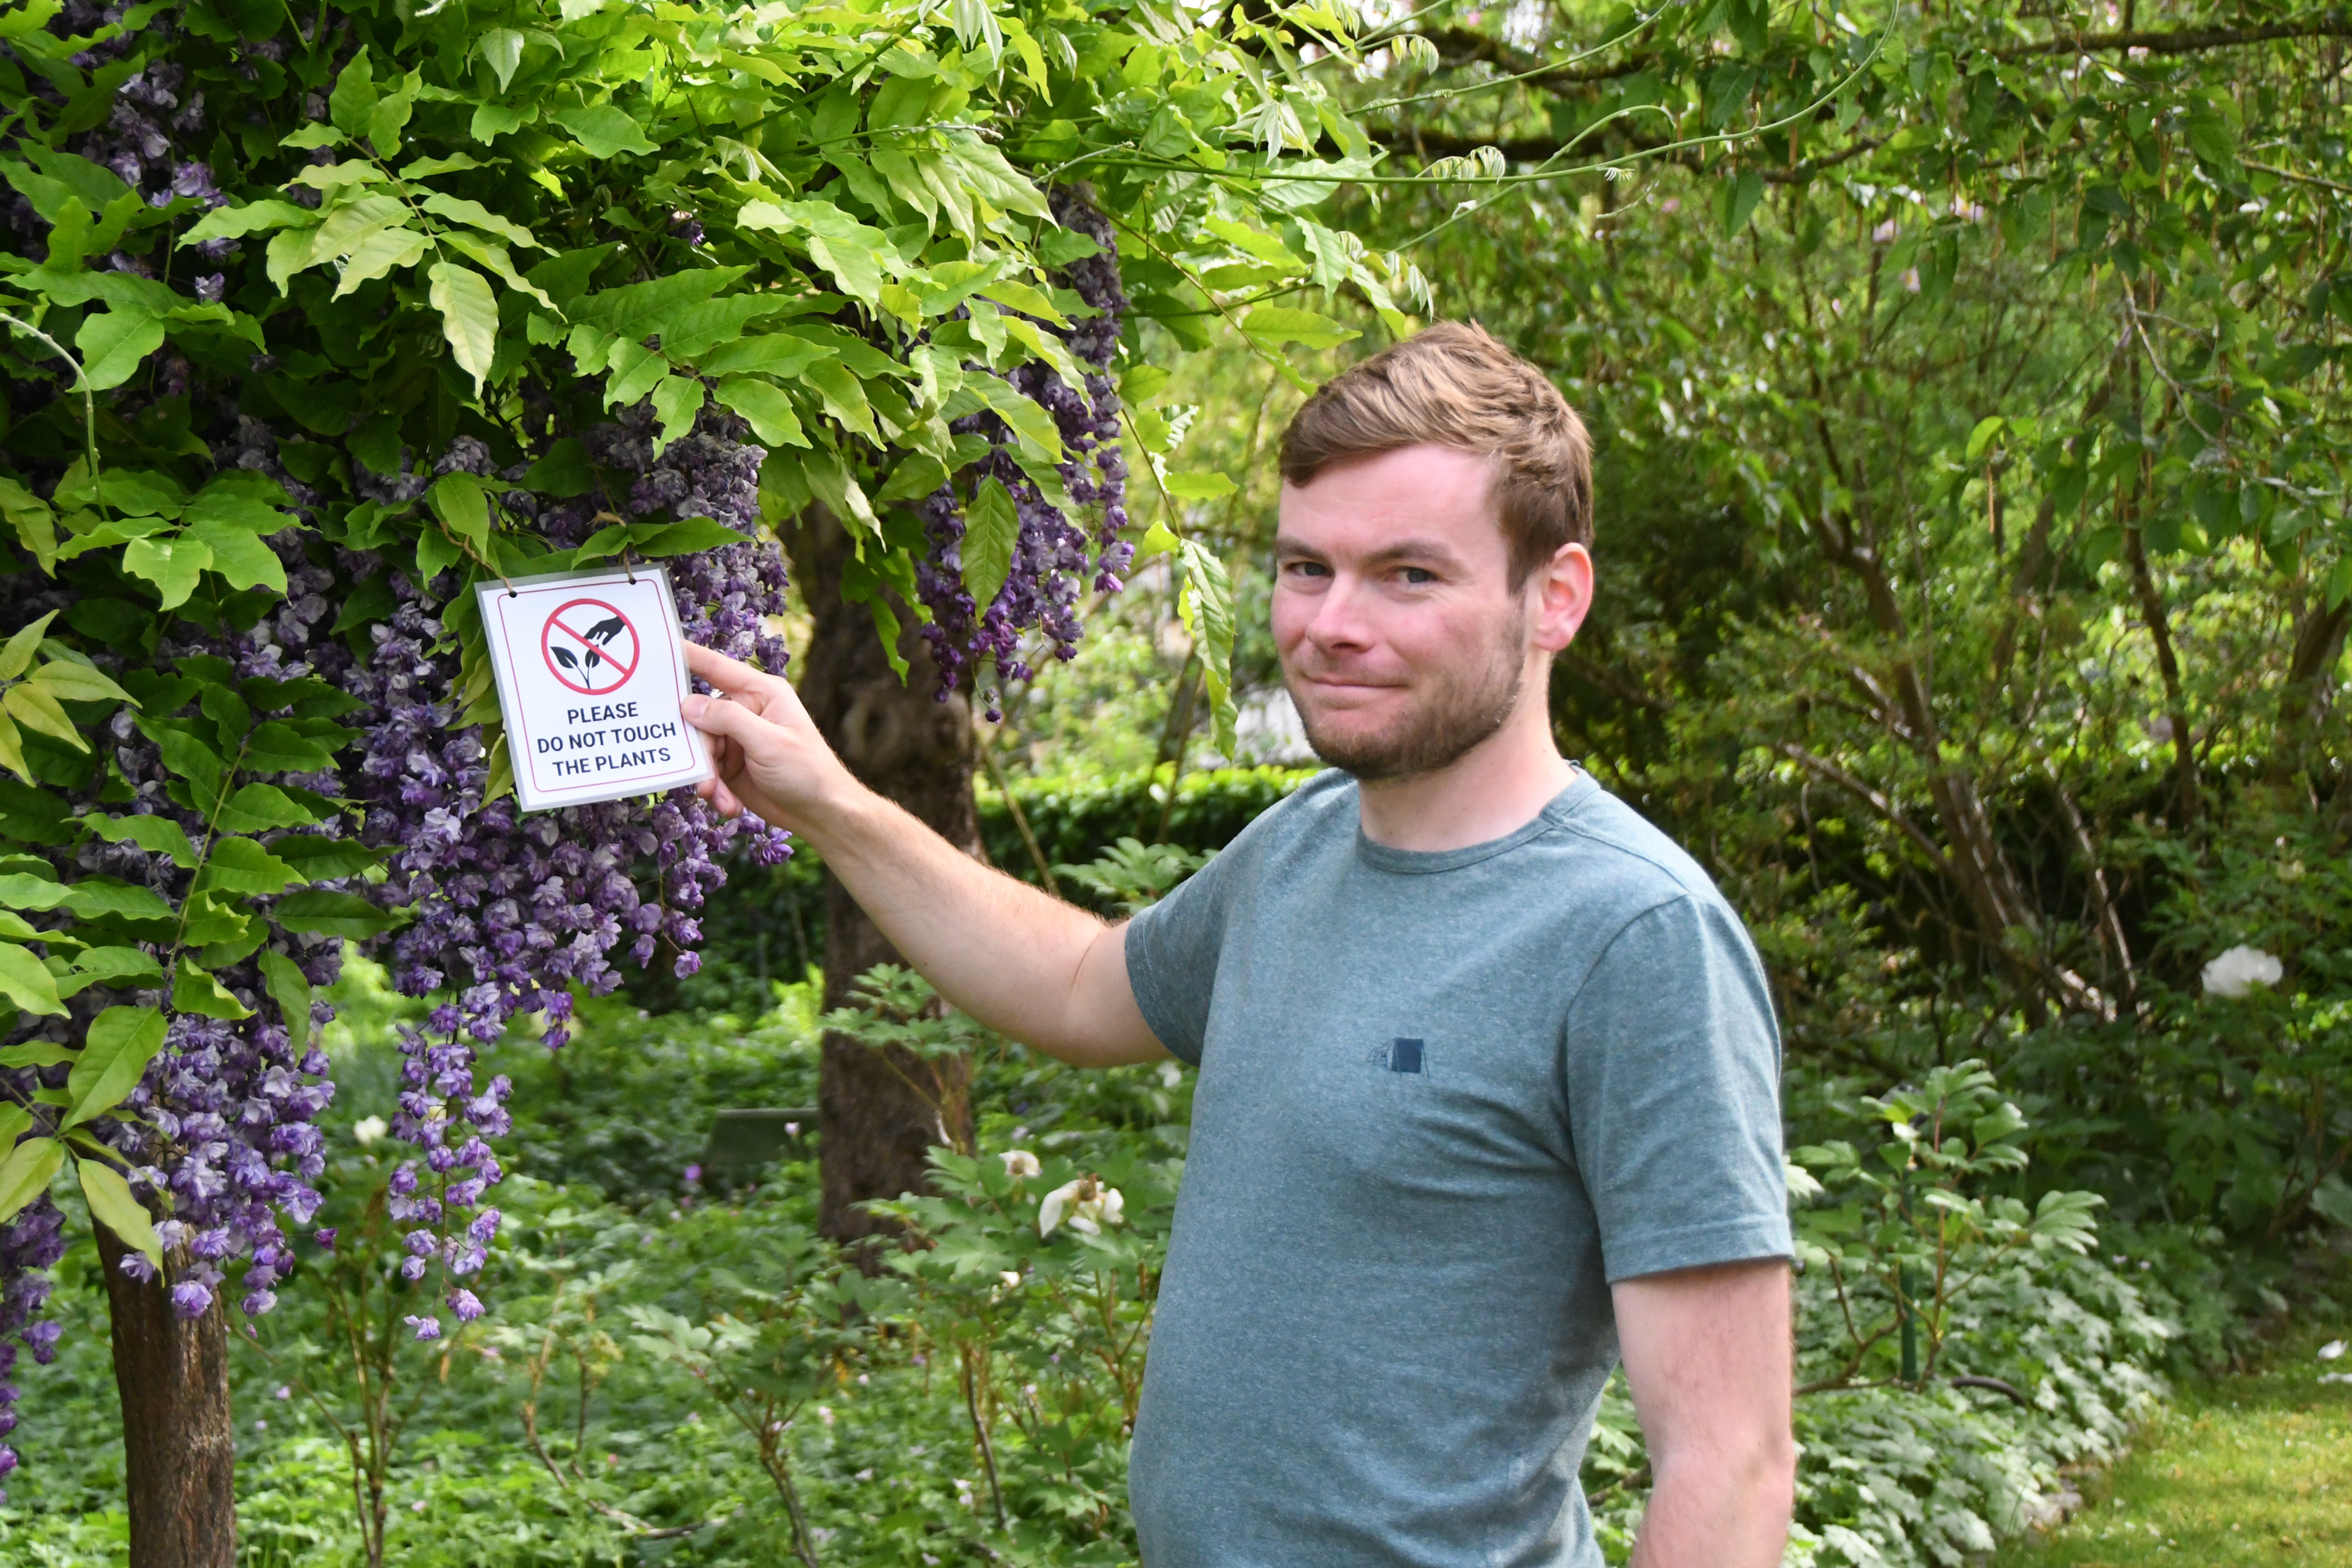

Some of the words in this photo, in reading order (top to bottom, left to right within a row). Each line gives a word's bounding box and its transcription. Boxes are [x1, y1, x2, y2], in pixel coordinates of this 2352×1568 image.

[567, 702, 639, 724] PLEASE
[537, 736, 564, 753] DO
[569, 731, 606, 750] NOT
[611, 722, 676, 744] TOUCH
[553, 757, 592, 777] THE
[596, 747, 671, 772] PLANTS
